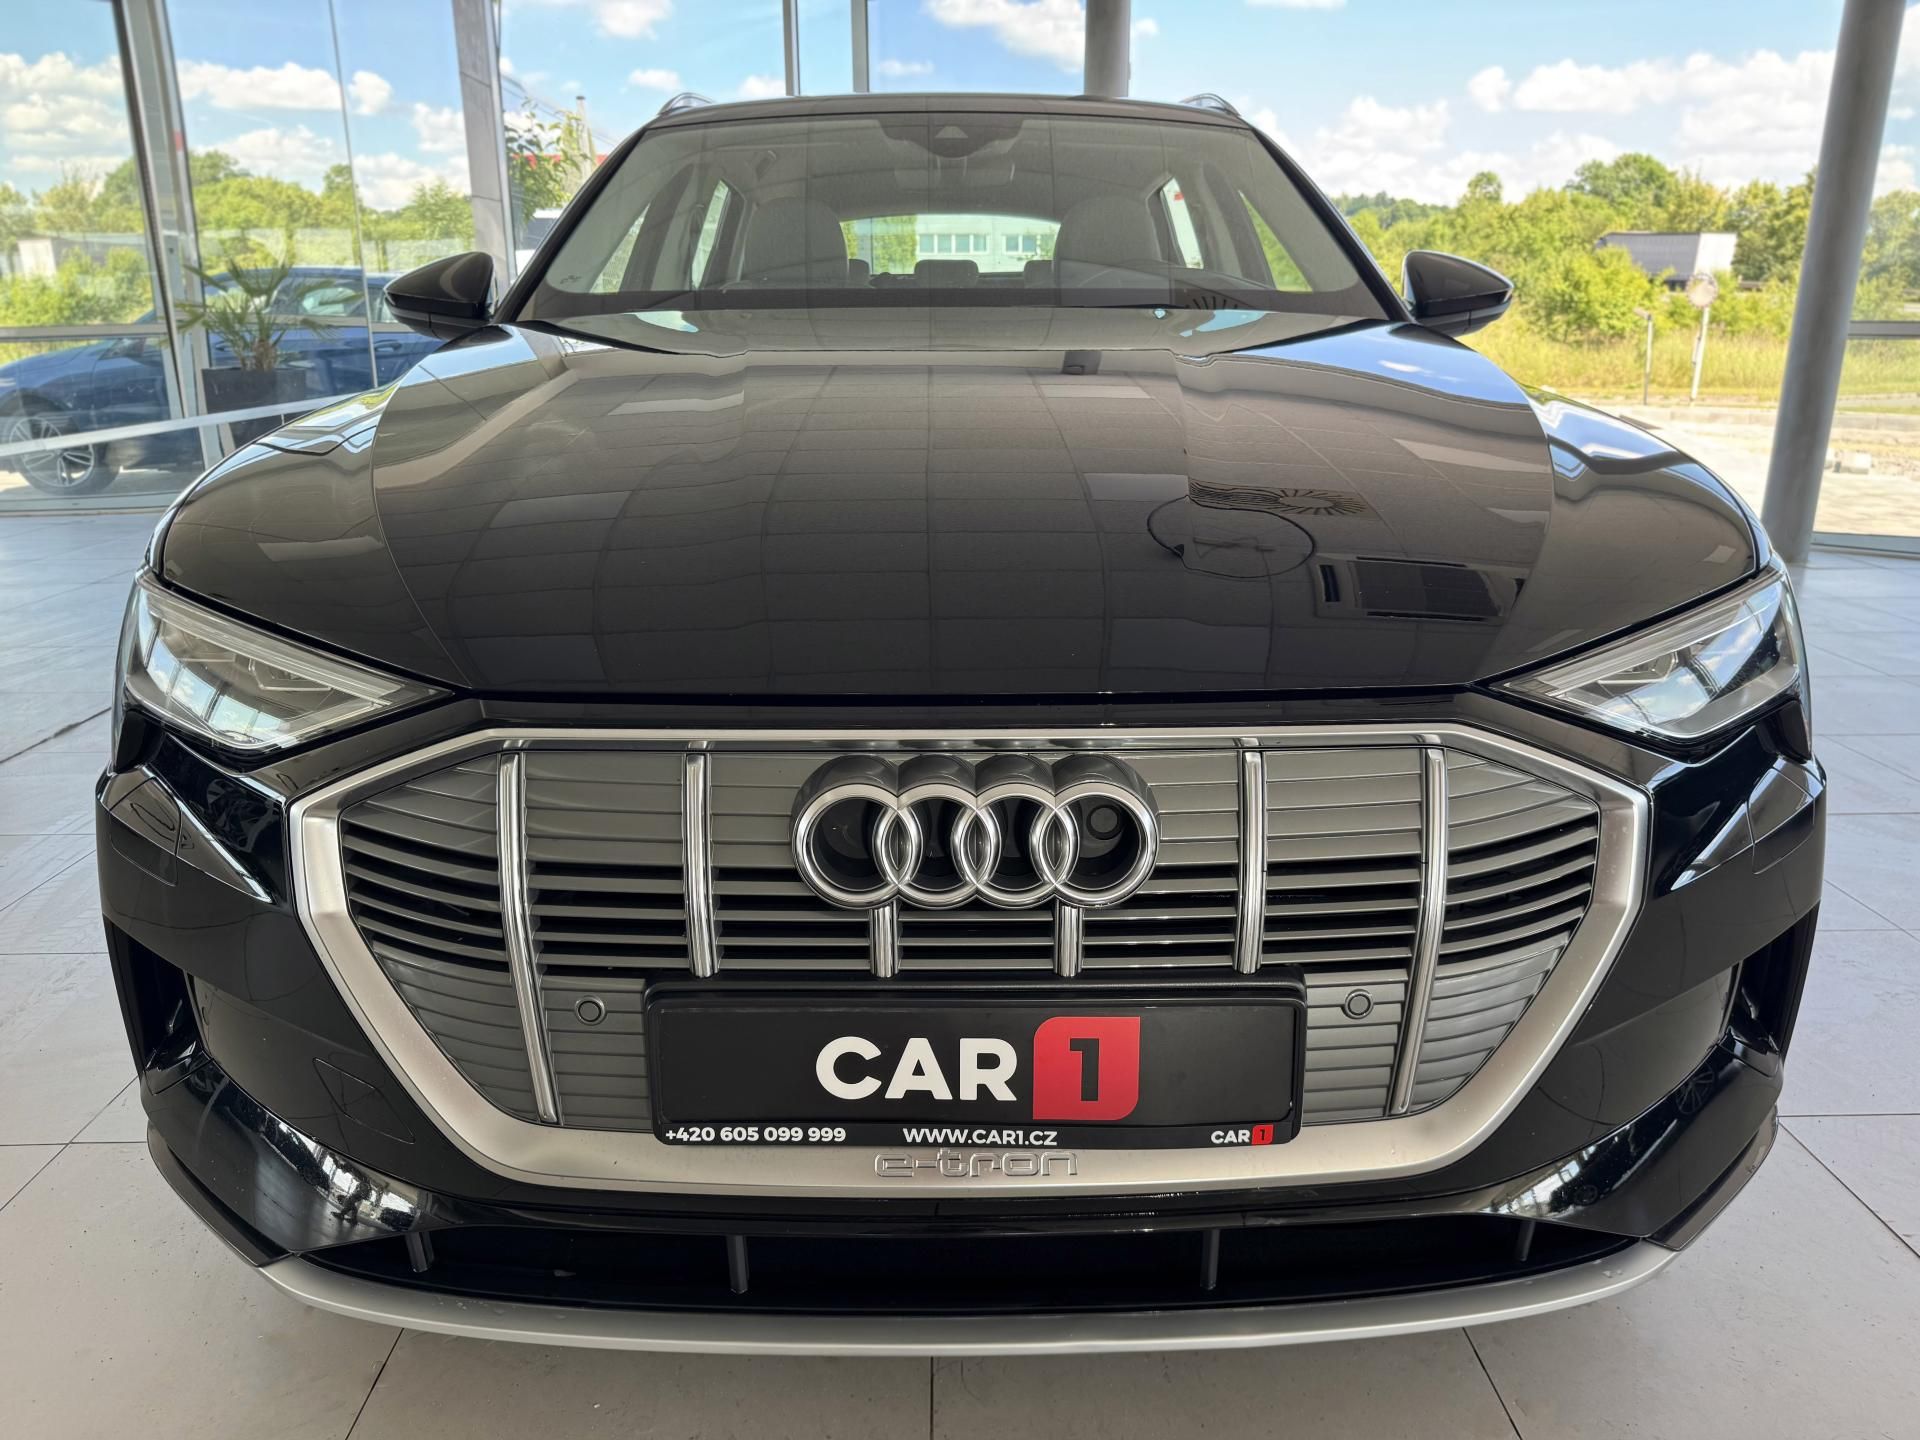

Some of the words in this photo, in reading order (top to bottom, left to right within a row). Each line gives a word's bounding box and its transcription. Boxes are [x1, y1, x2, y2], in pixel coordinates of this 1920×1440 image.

[815, 1036, 1018, 1101] CAR
[1068, 1037, 1100, 1102] 1
[665, 1126, 716, 1142] +420
[720, 1126, 760, 1142] 605
[764, 1126, 804, 1142] 099
[808, 1126, 846, 1142] 999
[902, 1127, 1058, 1146] WWW.CAR1.CZ
[1210, 1129, 1251, 1144] CAR
[874, 1147, 1078, 1178] e-tron
